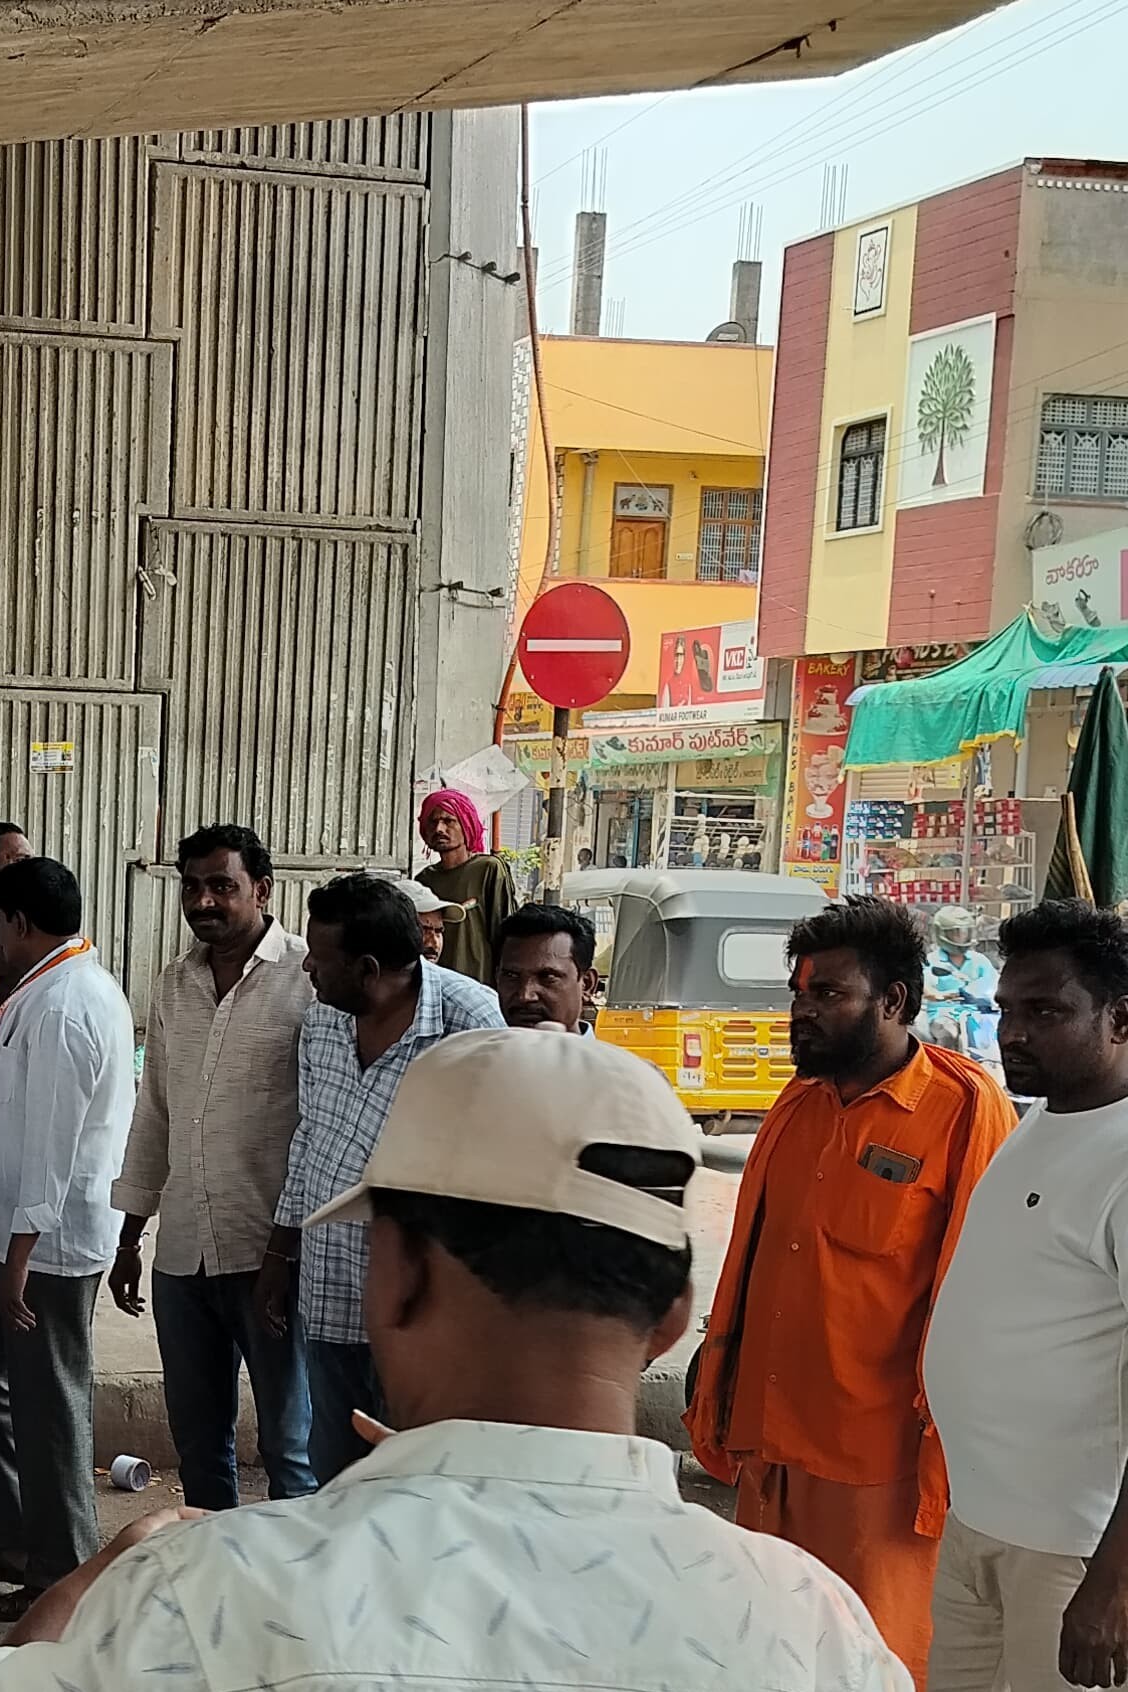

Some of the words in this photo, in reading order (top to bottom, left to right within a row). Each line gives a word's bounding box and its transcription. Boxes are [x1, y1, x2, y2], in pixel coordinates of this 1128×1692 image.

[725, 649, 745, 669] VKC
[807, 662, 850, 676] BAKERY
[678, 709, 708, 721] FOOTWEAR
[628, 731, 685, 754] కుమార్
